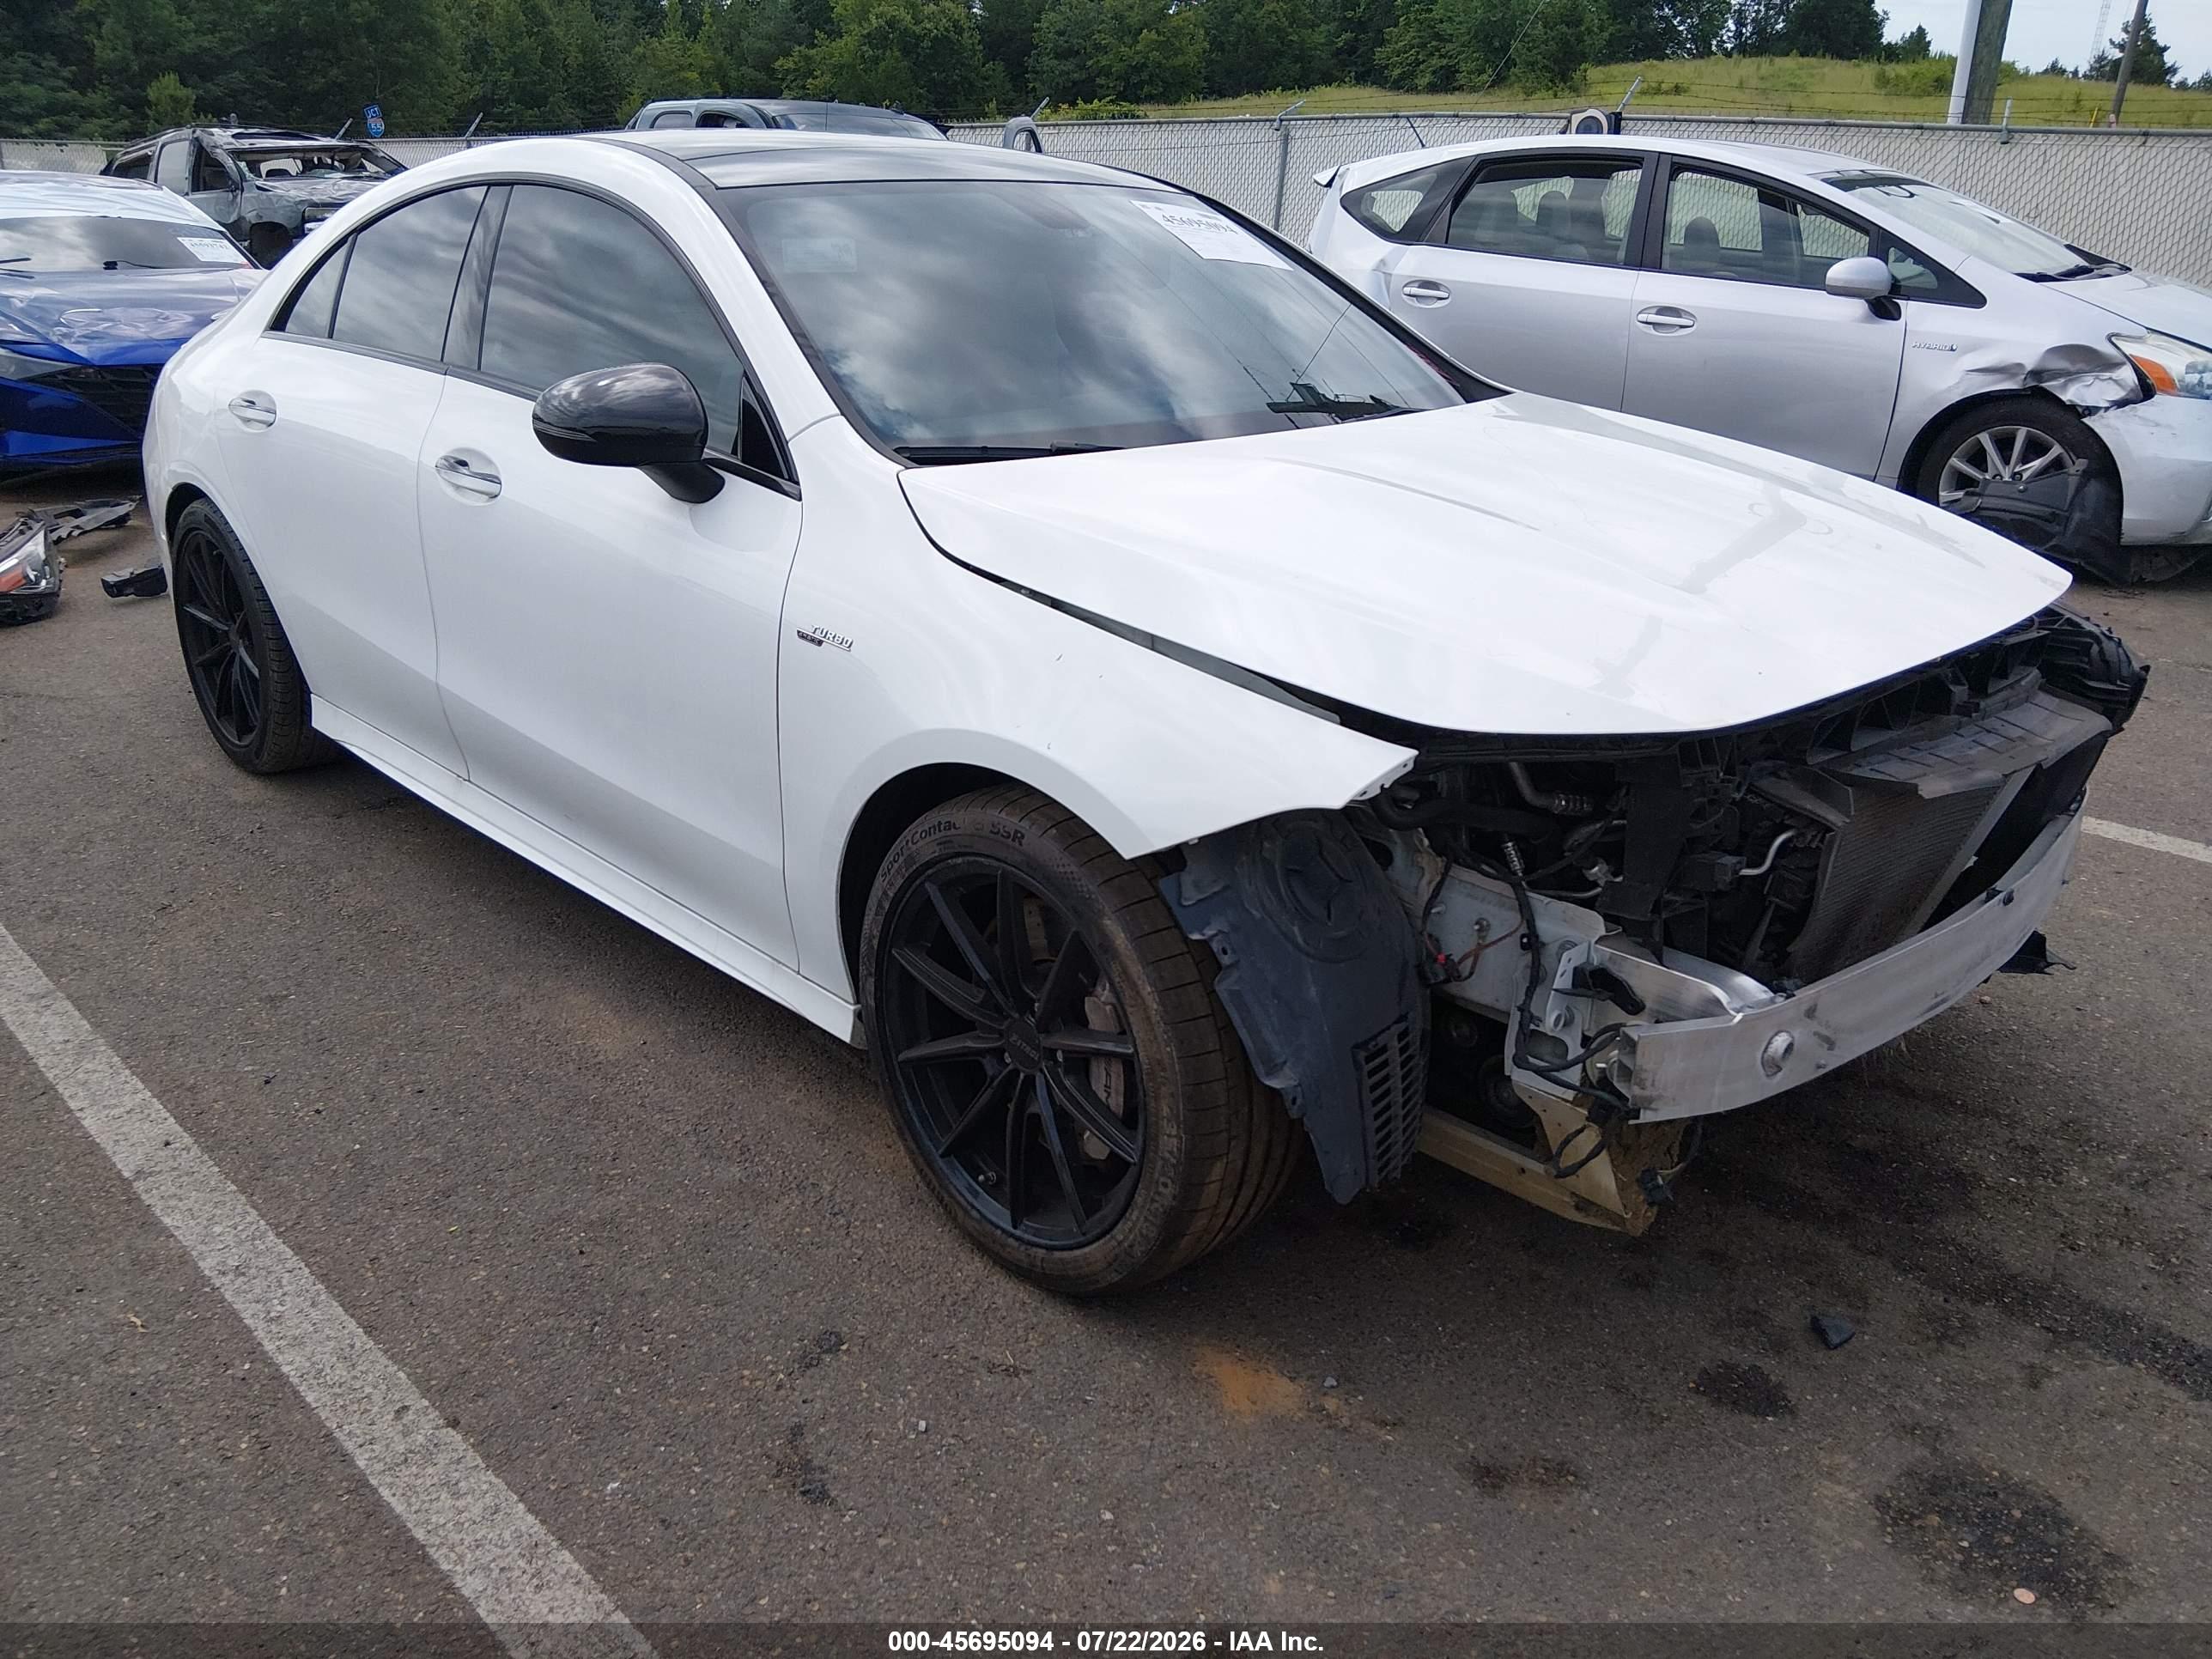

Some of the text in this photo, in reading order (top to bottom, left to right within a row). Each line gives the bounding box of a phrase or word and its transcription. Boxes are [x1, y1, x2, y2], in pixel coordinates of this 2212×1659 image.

[367, 107, 380, 118] JCT
[1912, 342, 1950, 351] HYBRID
[811, 625, 853, 649] TURBO
[989, 821, 1025, 848] SSR
